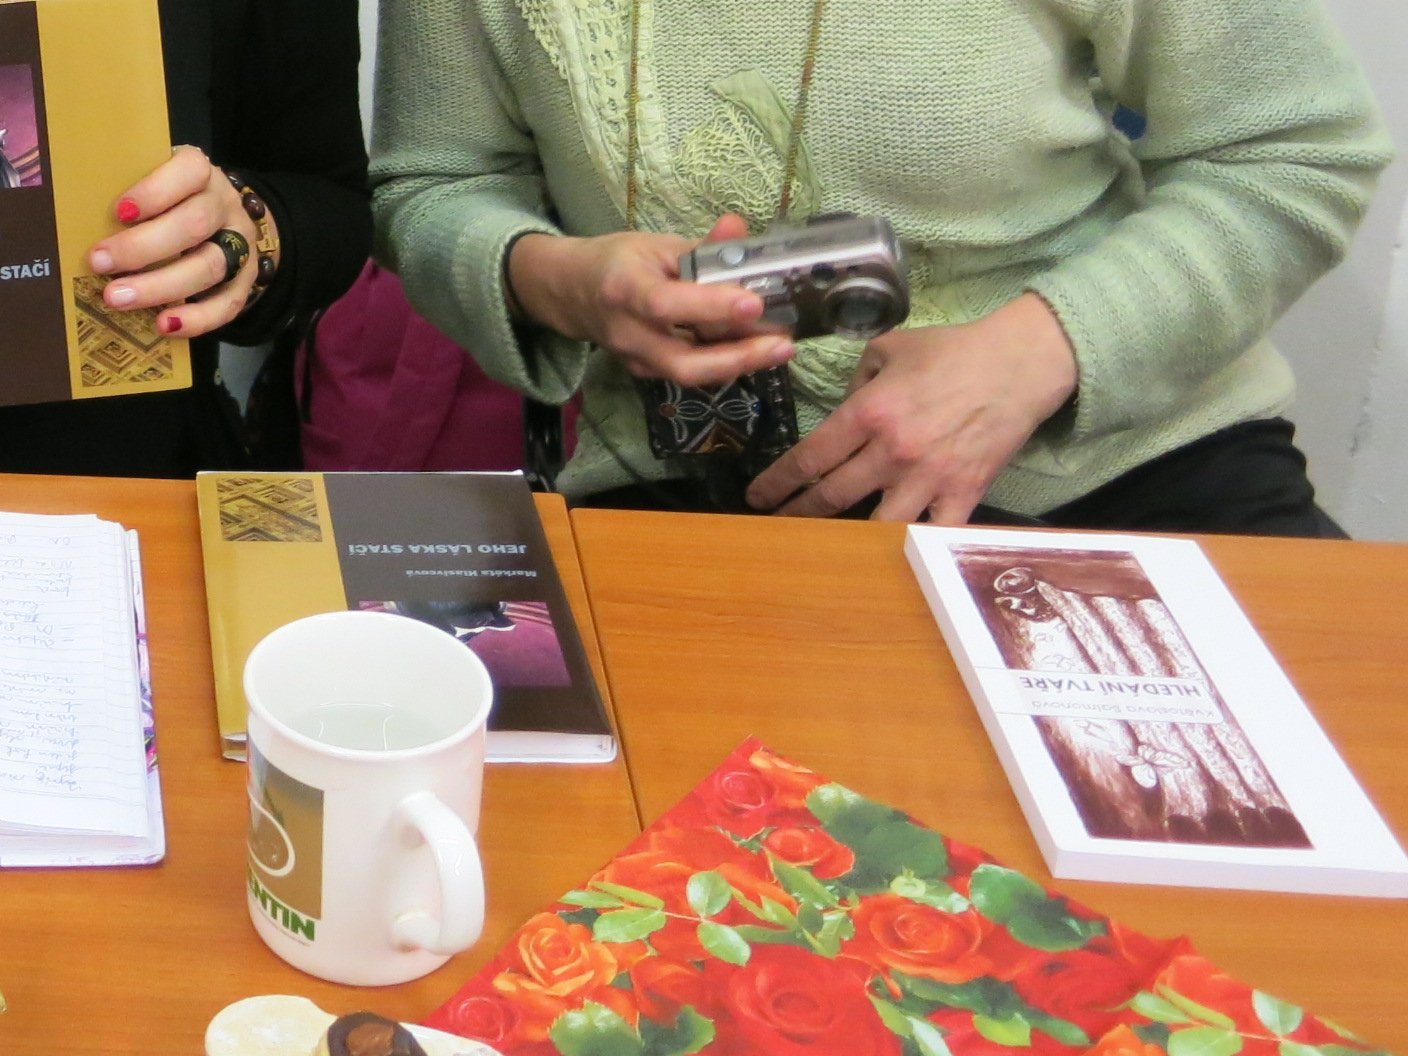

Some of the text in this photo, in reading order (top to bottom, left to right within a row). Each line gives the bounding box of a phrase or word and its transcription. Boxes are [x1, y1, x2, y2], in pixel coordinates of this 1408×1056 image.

[0, 258, 51, 281] STAČÍ
[348, 543, 528, 556] JEHO LÁSKA STAČÍ
[480, 569, 538, 578] Markéta
[1019, 675, 1202, 698] HLEDÁNÍ TVÁŘE
